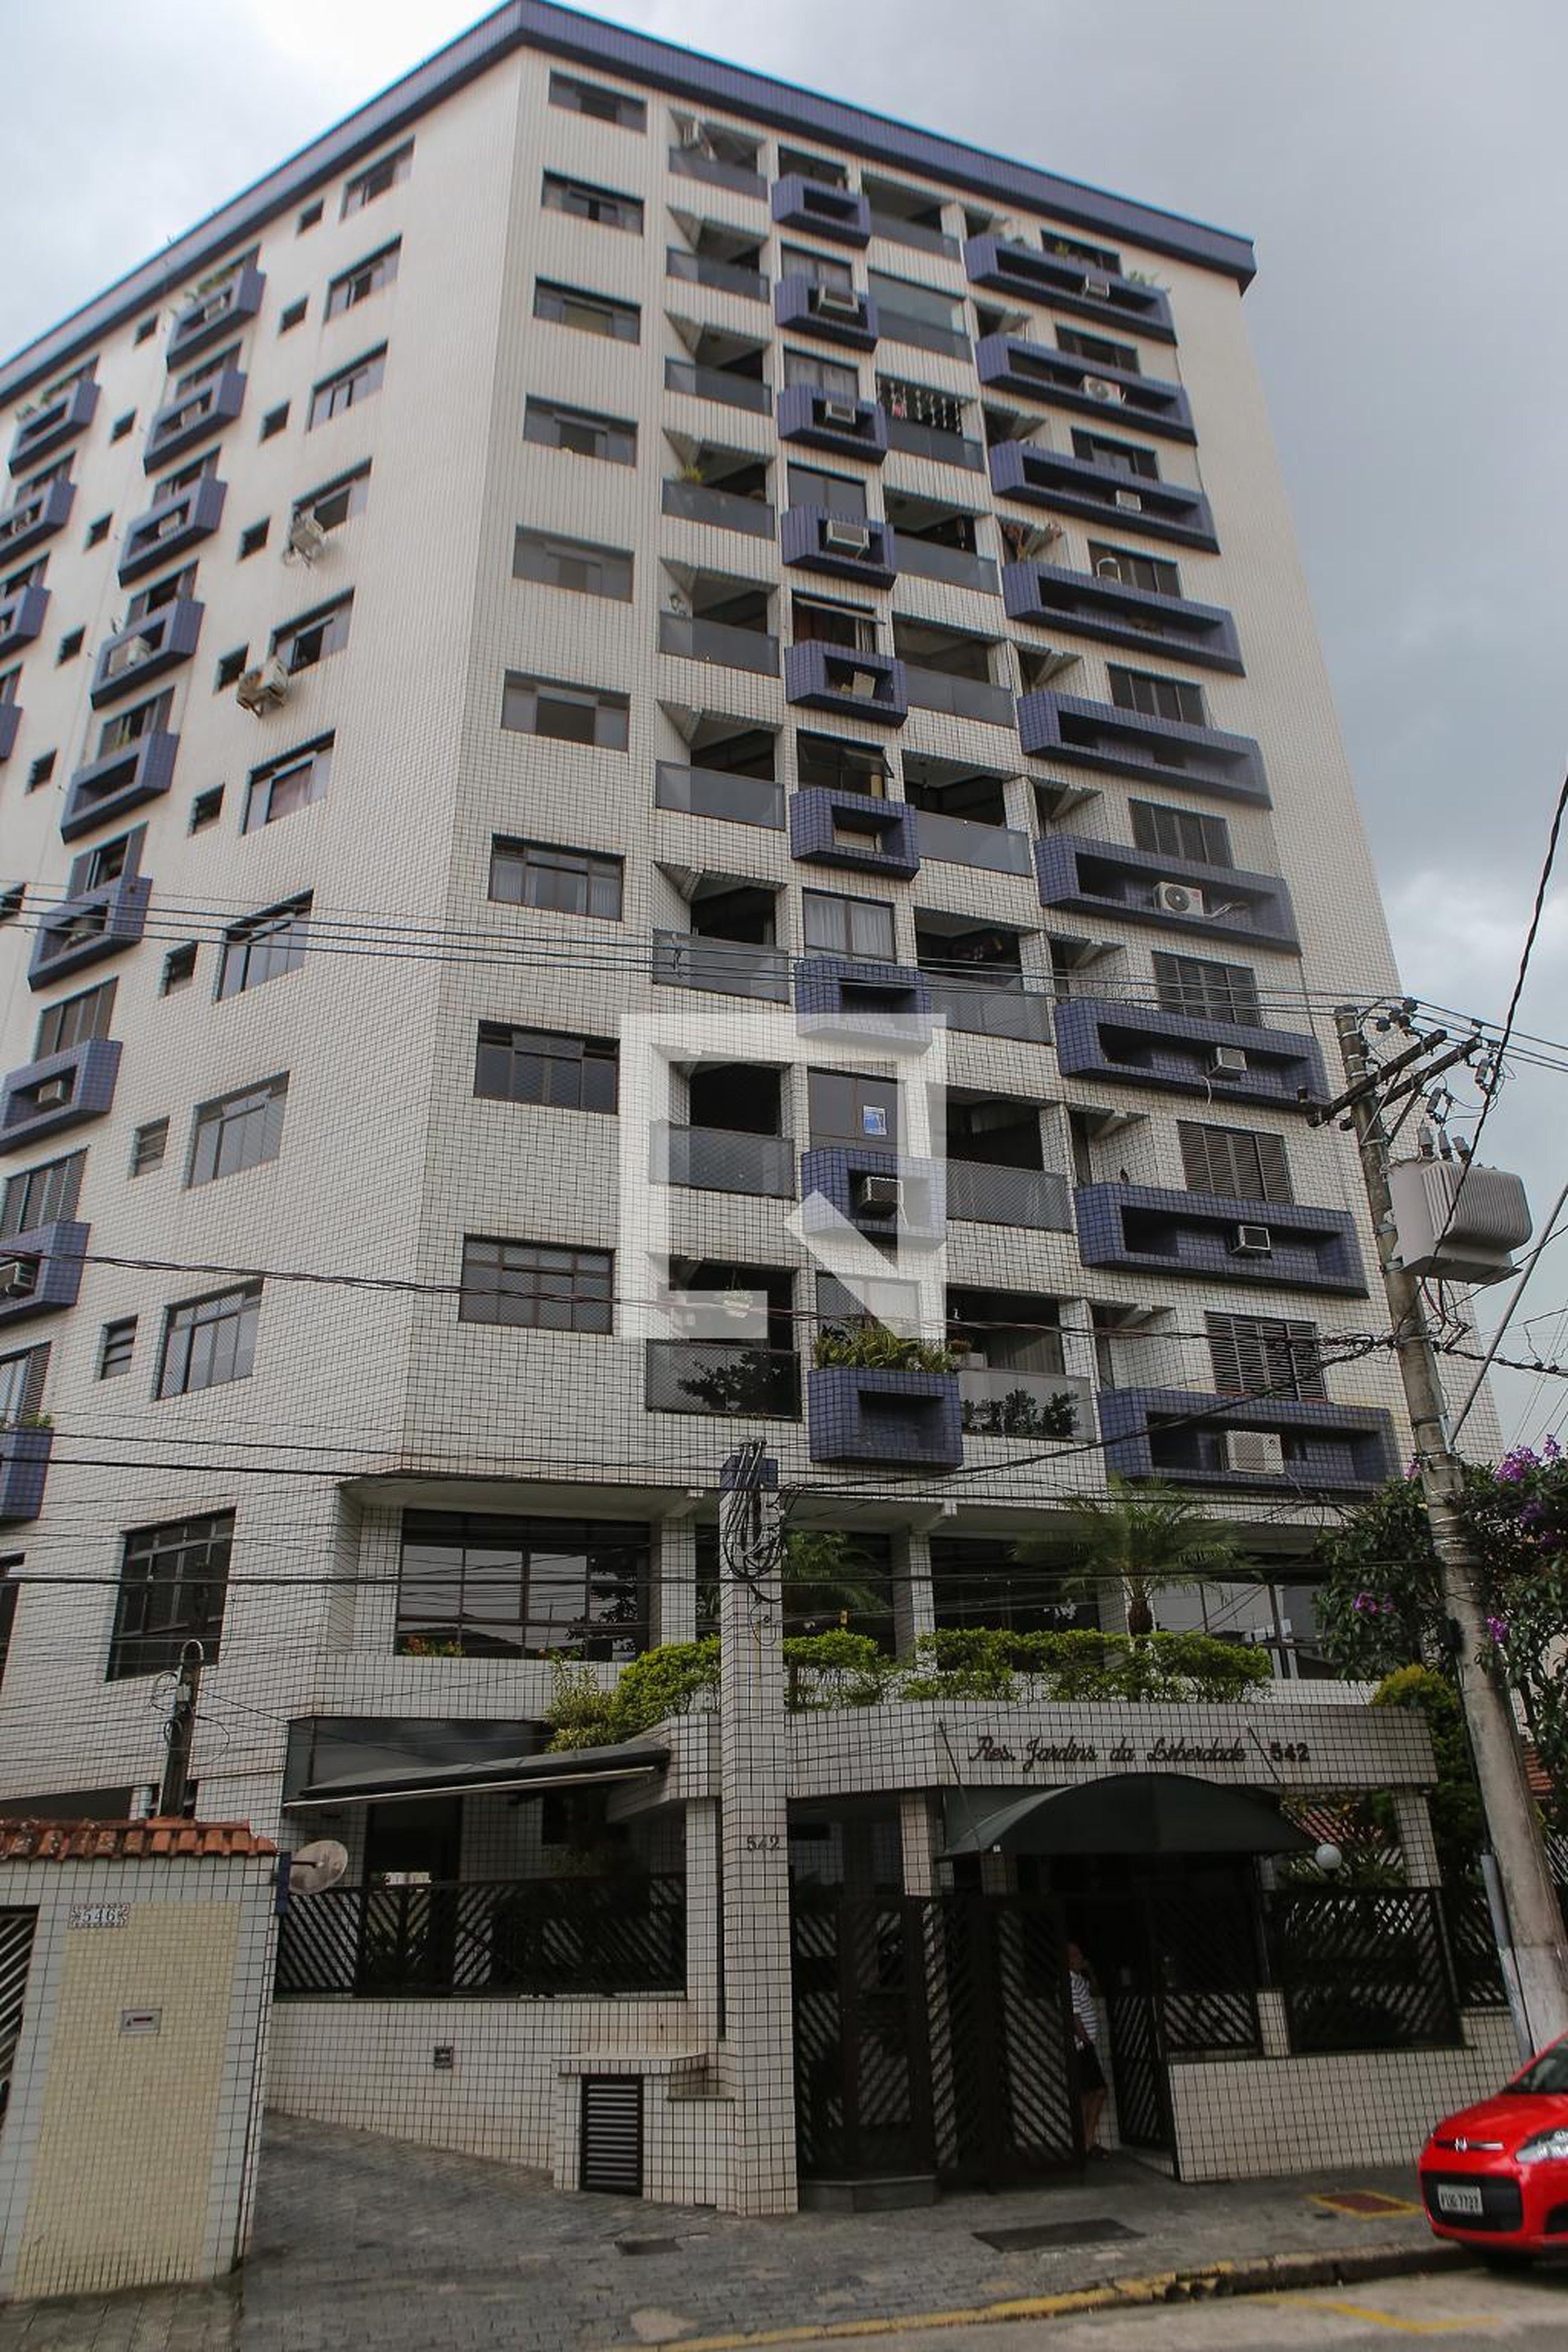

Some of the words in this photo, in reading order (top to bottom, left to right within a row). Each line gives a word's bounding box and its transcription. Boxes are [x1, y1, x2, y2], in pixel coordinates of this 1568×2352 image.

[1022, 1735, 1098, 1773] Jardins
[1110, 1736, 1136, 1762] da
[1147, 1737, 1247, 1762] Liberdade
[1270, 1742, 1310, 1762] 542
[747, 1835, 780, 1852] 542
[83, 1909, 115, 1922] 546
